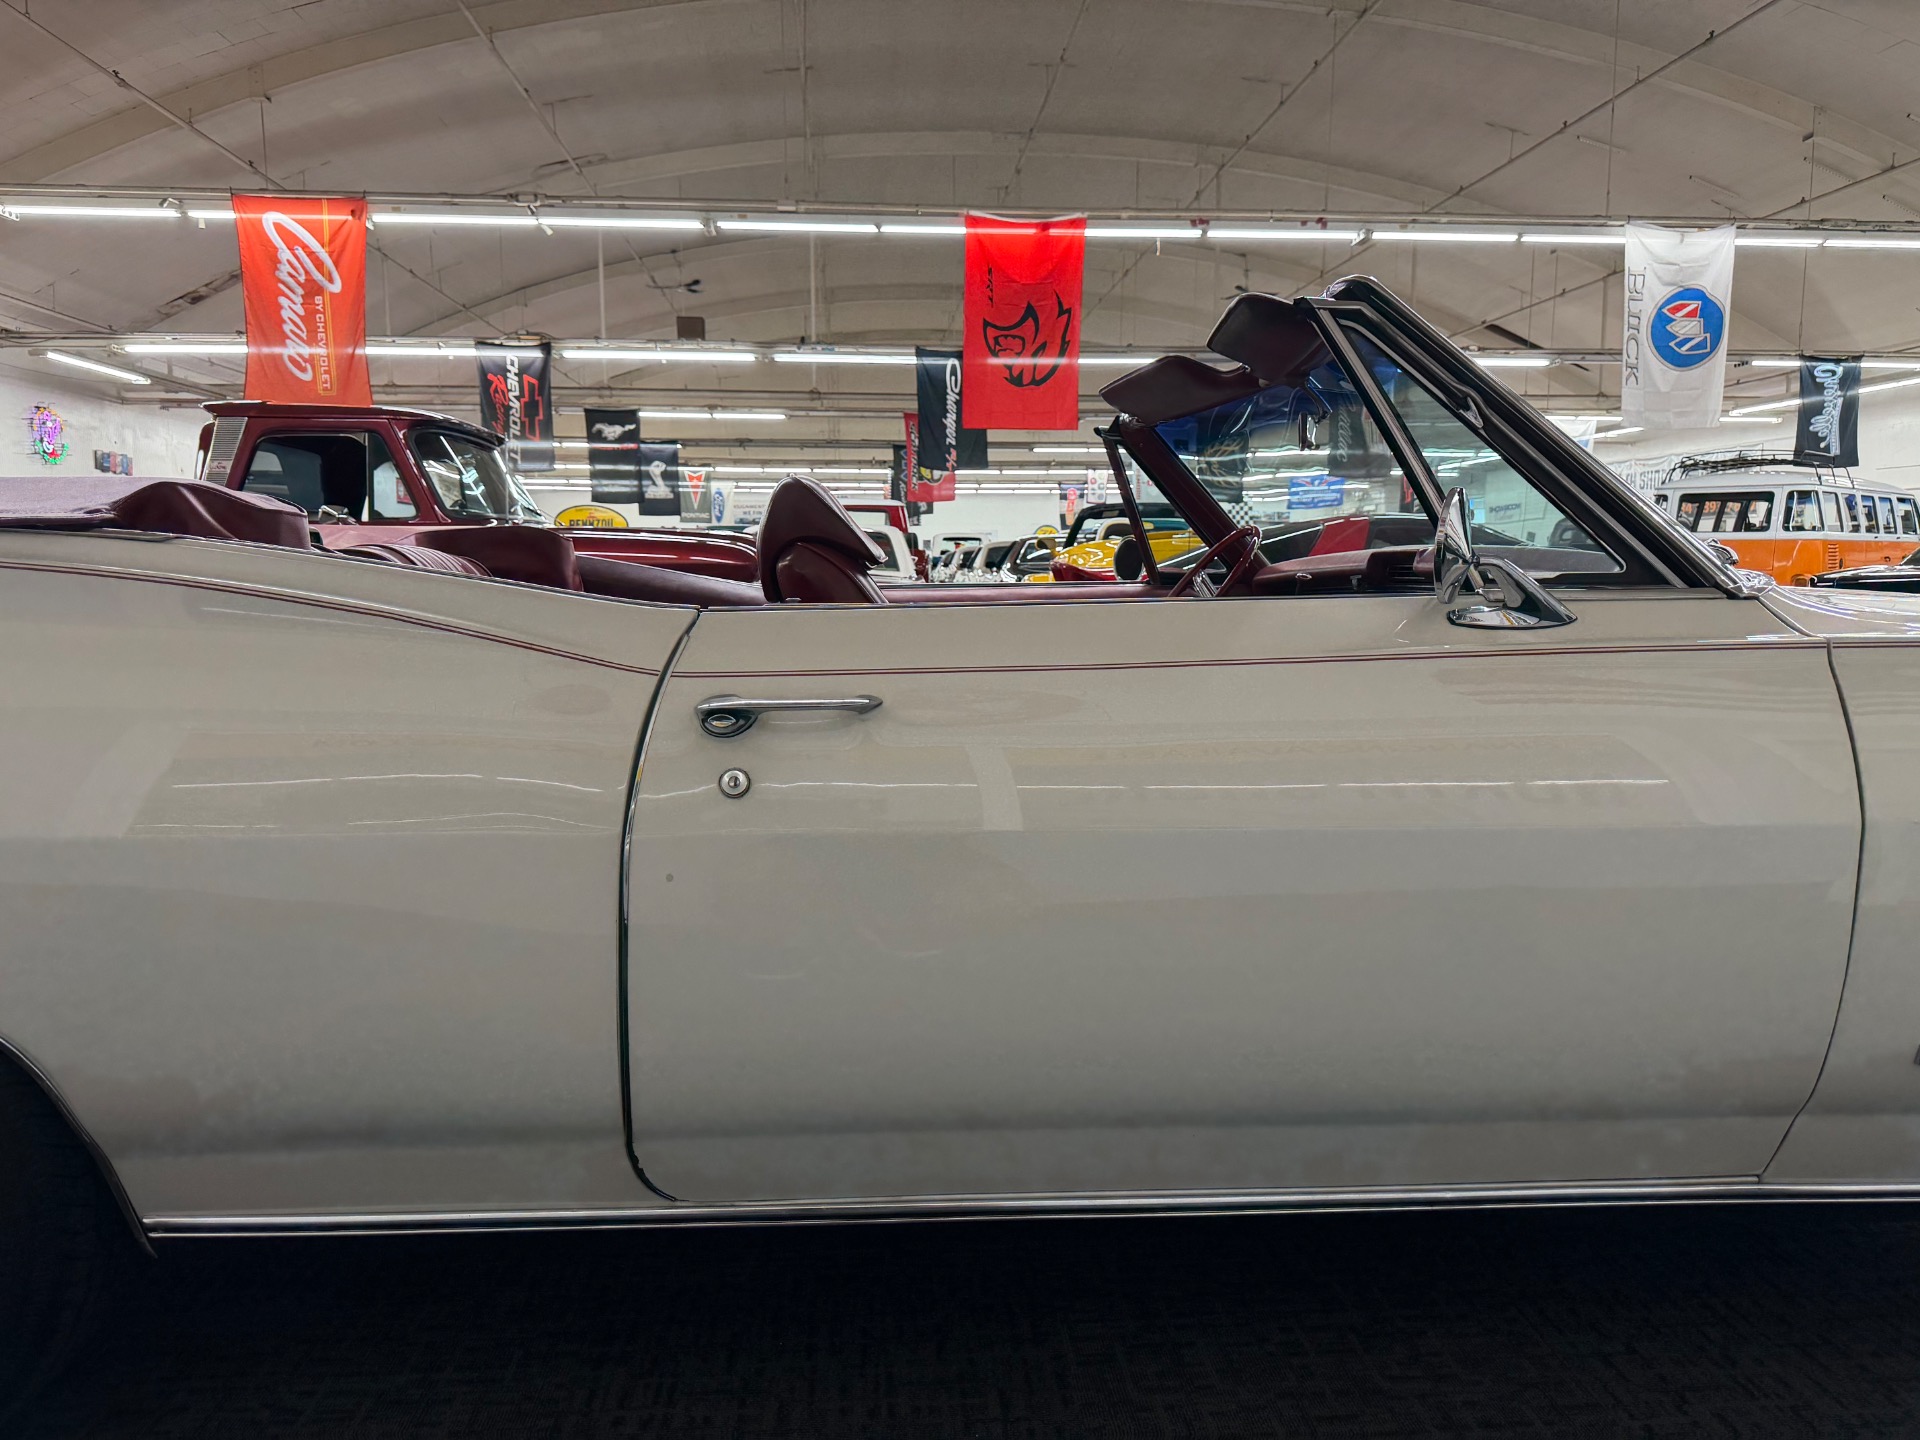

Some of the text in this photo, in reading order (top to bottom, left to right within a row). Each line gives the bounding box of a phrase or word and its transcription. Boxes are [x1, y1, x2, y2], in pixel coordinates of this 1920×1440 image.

[262, 211, 342, 382] Camaro
[314, 296, 331, 390] BY CHEVROLET
[1625, 266, 1647, 386] BUICK
[487, 373, 509, 434] Racing
[506, 354, 522, 465] CHEVROLET
[942, 357, 961, 446] Charger
[714, 493, 724, 517] Ford
